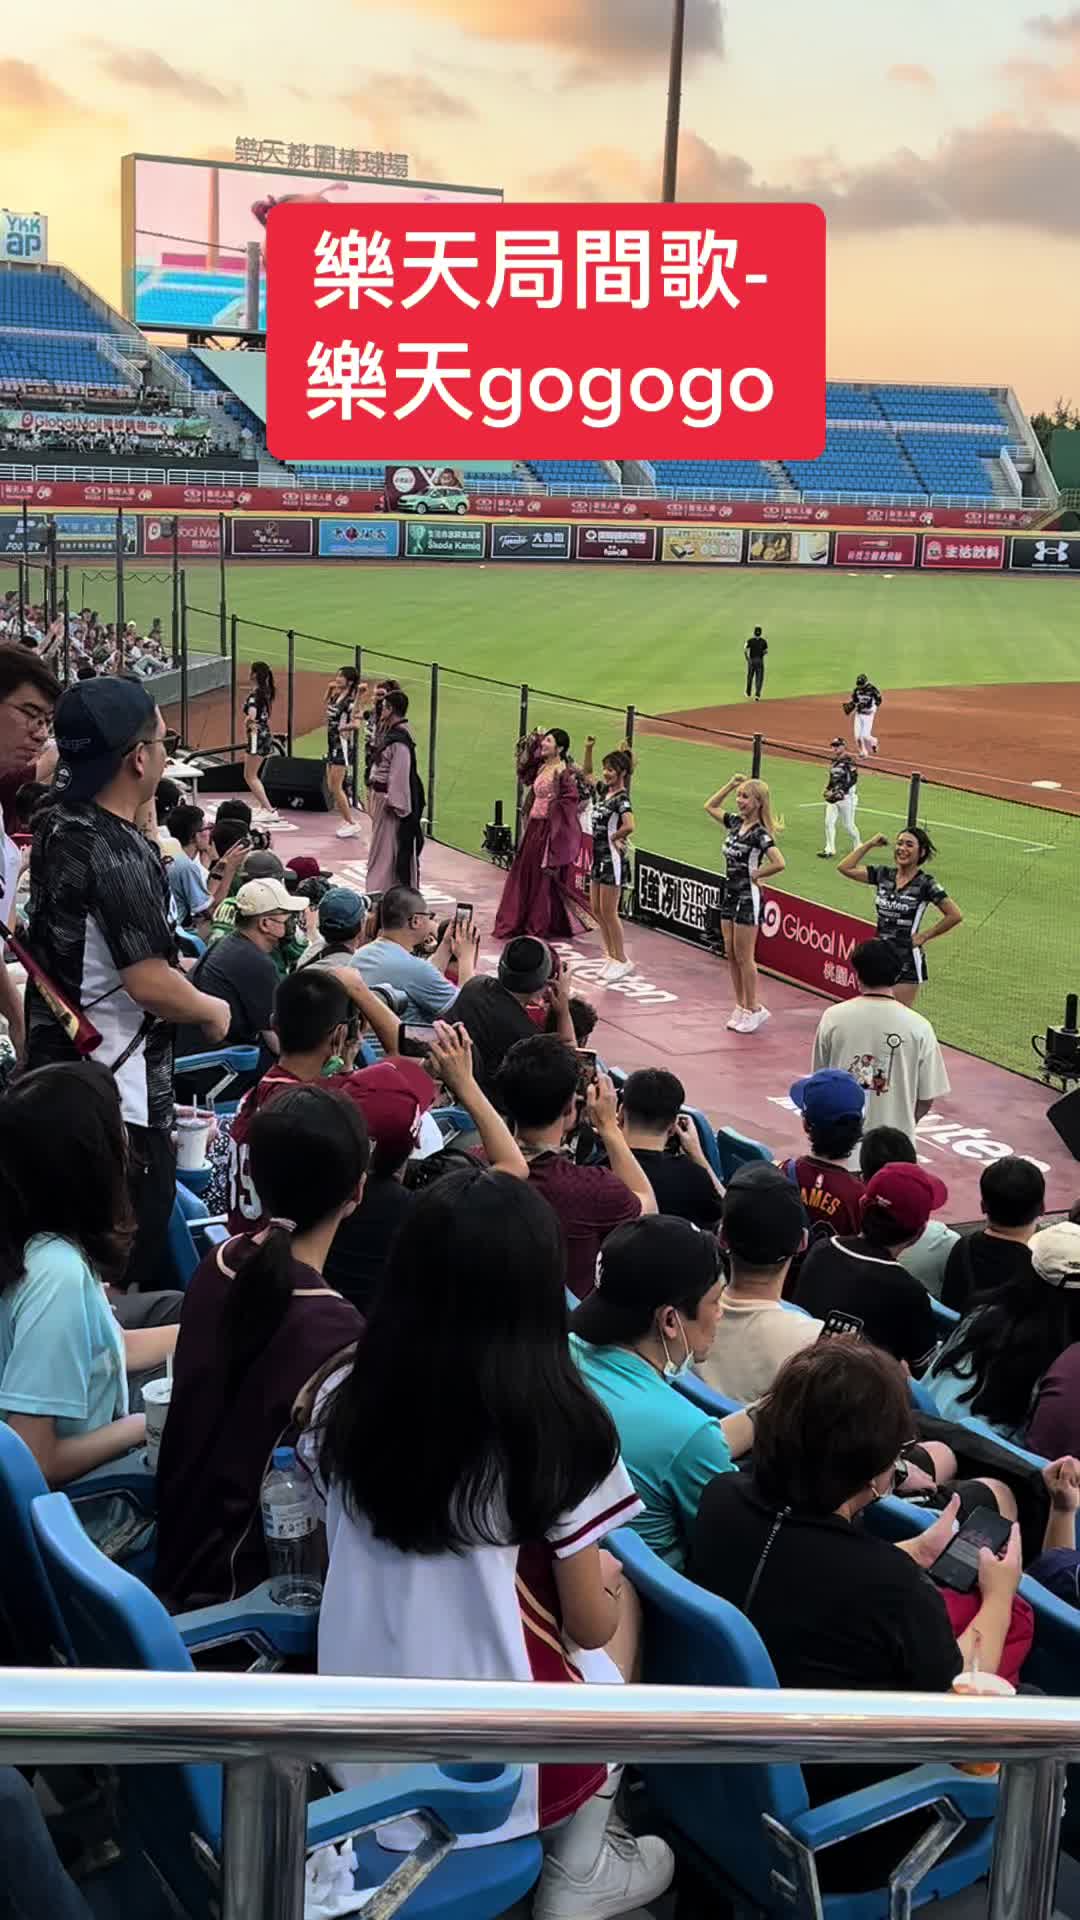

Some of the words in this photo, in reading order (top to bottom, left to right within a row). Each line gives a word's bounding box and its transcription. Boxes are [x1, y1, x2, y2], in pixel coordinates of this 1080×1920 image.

[235, 136, 408, 178] 樂天桃園棒球場
[6, 215, 41, 232] YKK
[682, 879, 722, 910] STRON
[782, 913, 836, 956] Global
[800, 1186, 842, 1217] AMES
